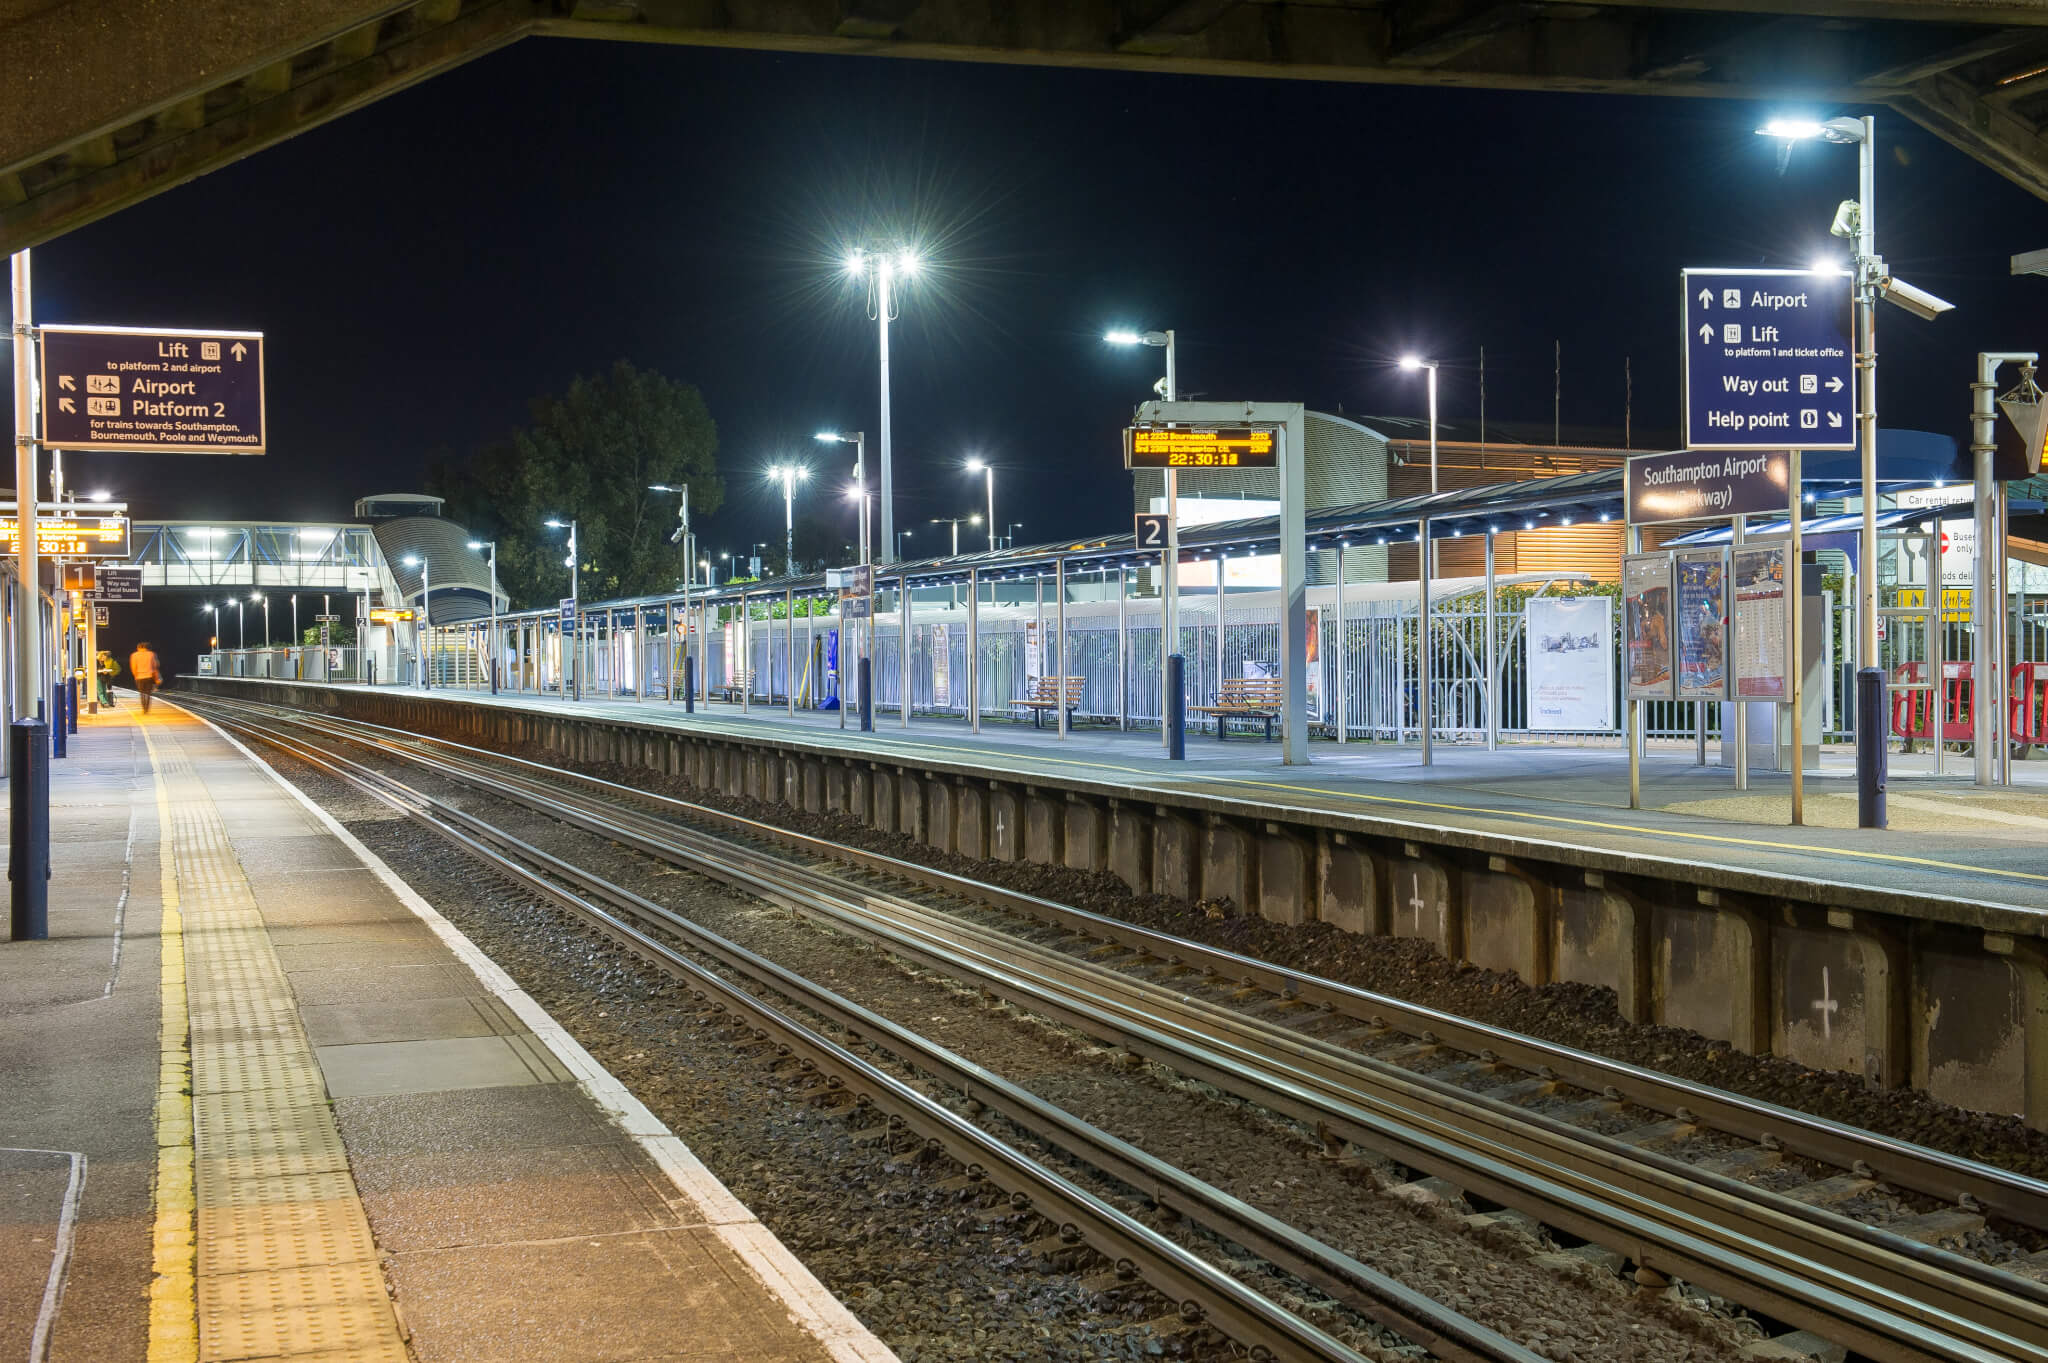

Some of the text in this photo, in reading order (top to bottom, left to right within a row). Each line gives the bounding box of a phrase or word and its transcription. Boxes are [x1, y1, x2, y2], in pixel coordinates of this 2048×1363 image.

[1751, 291, 1808, 310] Airport
[1752, 326, 1779, 342] Lift
[158, 342, 189, 358] Lift
[1735, 348, 1770, 358] platform
[1778, 348, 1793, 356] and
[1795, 348, 1818, 356] ticket
[1820, 348, 1844, 357] office
[120, 362, 160, 372] platform
[162, 363, 169, 371] 2
[171, 363, 188, 372] and
[190, 364, 221, 374] airport
[132, 378, 196, 397] Airport
[1723, 376, 1790, 395] Way out
[133, 400, 225, 417] Platform 2
[90, 420, 240, 434] for trains towards Southampton,
[1708, 411, 1790, 430] Help point
[91, 431, 258, 444] Bournemouth, Poole and Weymouth
[1644, 454, 1767, 486] Southampton Airport
[1909, 496, 1922, 504] Car
[1926, 496, 1950, 504] rental
[1145, 519, 1161, 545] 2
[1956, 544, 1973, 554] only
[74, 567, 83, 586] 1
